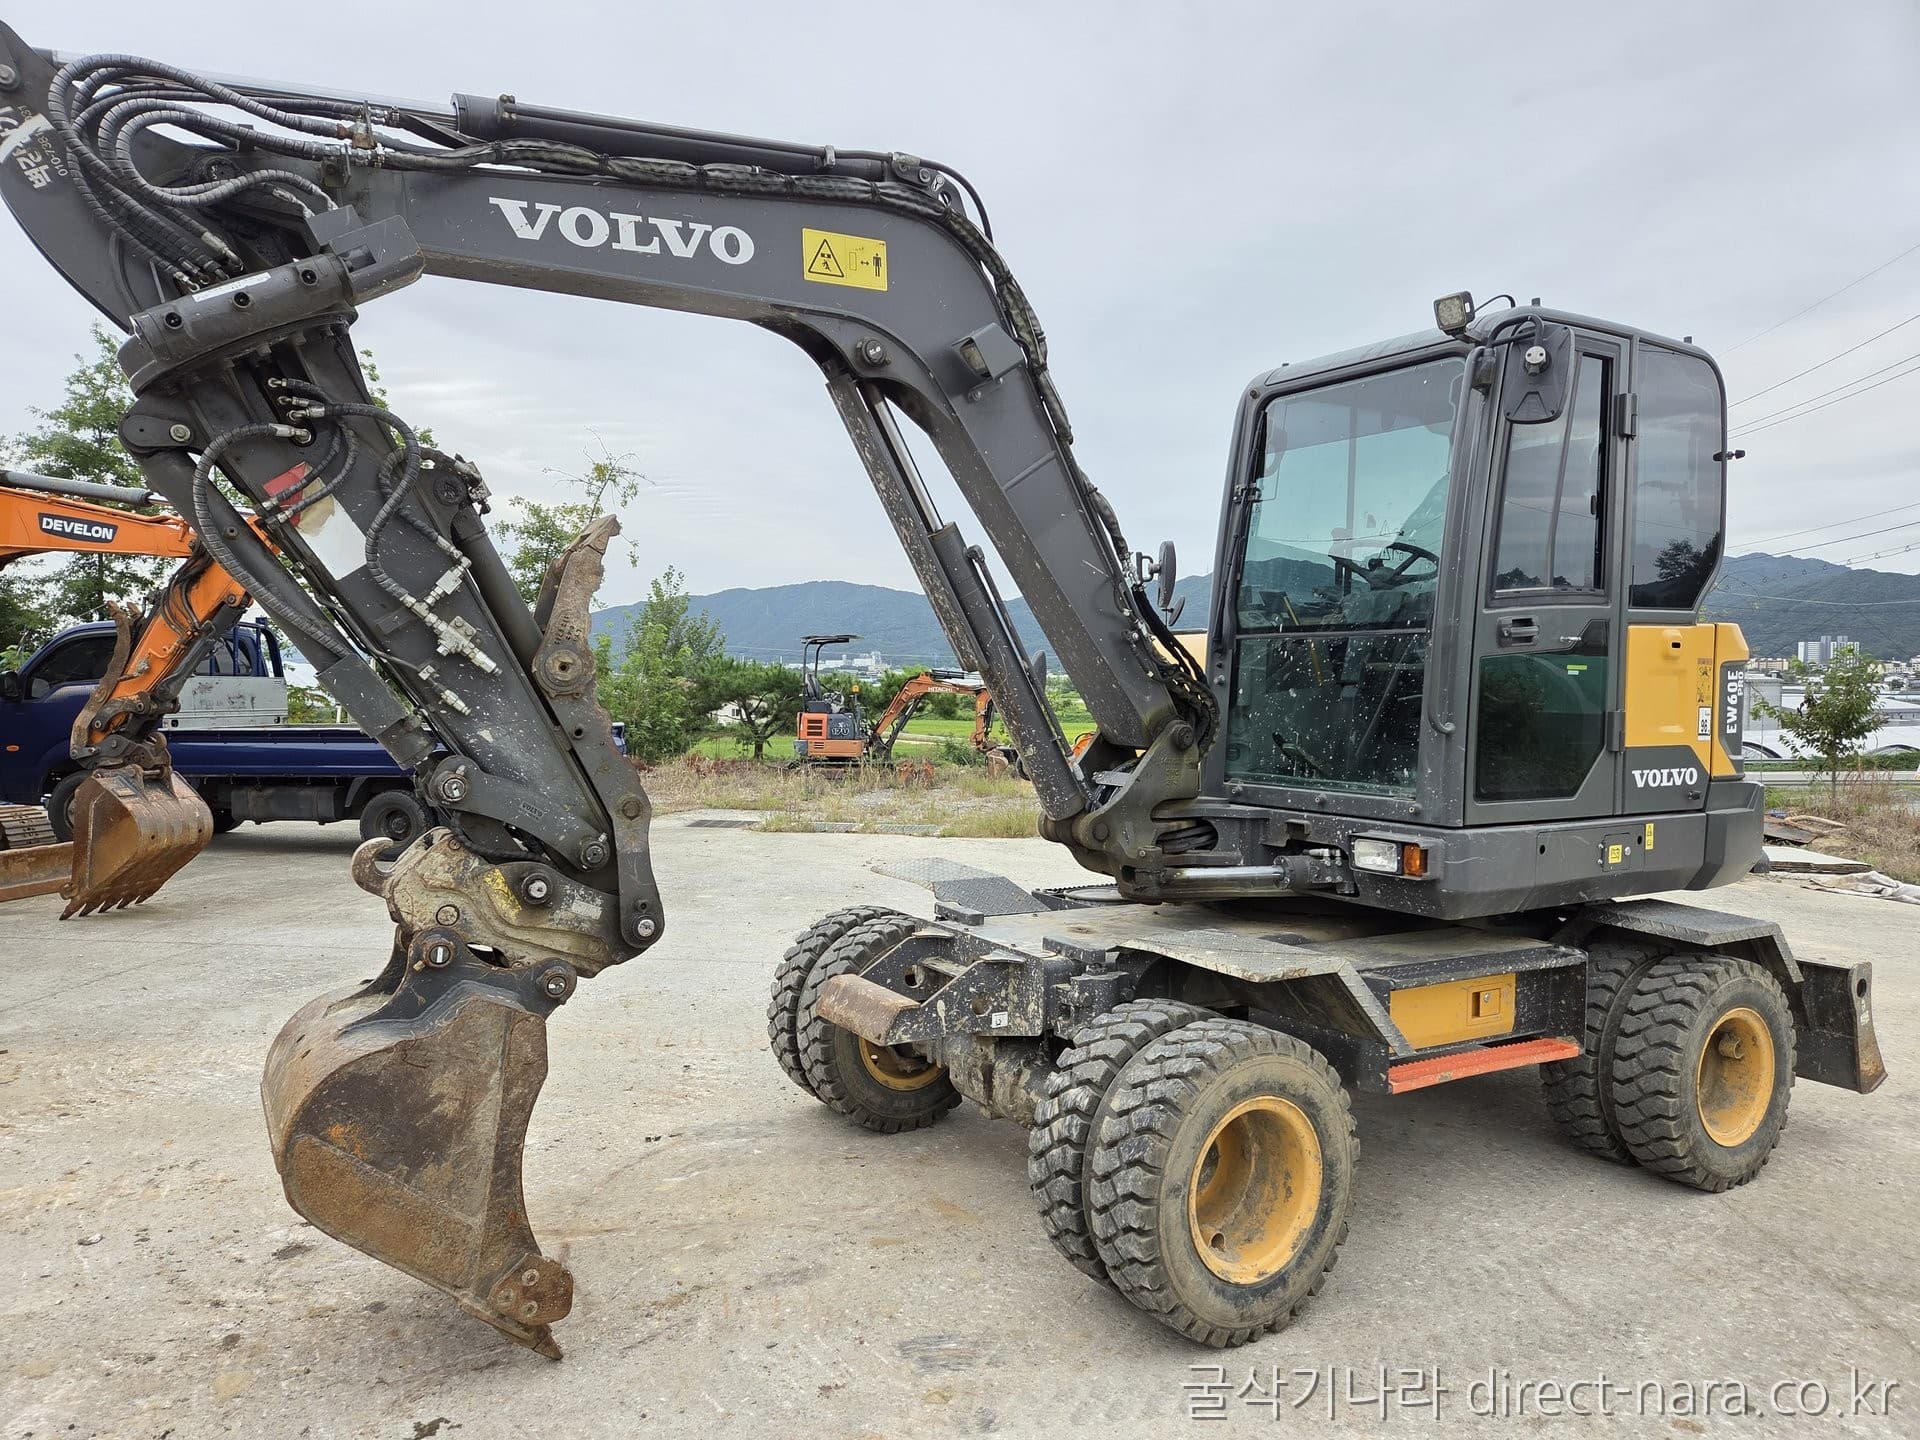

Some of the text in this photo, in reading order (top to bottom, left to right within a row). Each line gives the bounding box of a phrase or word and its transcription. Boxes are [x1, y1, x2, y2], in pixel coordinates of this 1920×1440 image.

[489, 197, 755, 265] VOLVO
[41, 517, 114, 540] DEVELON
[1726, 670, 1738, 734] EW60E
[1631, 767, 1698, 788] VOLVO
